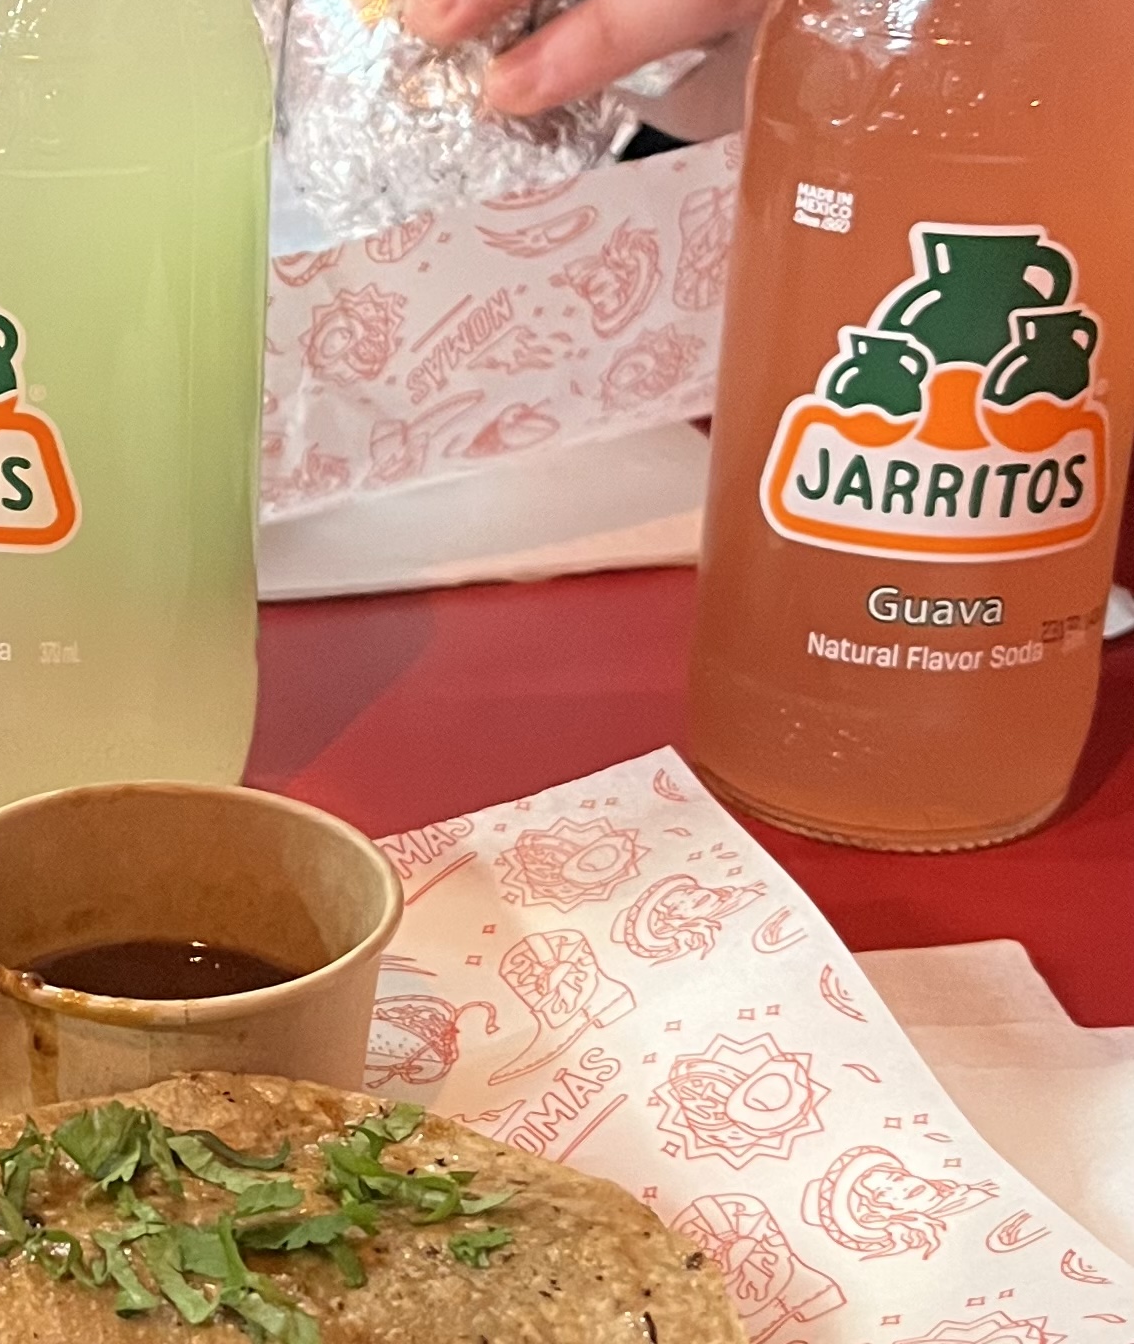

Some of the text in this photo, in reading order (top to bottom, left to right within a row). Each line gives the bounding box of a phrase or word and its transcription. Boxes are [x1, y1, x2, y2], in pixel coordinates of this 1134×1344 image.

[795, 195, 853, 219] MEXICO
[797, 181, 854, 206] MADE IN
[796, 448, 1087, 518] JARRITOS
[867, 586, 1005, 626] Guava
[807, 632, 899, 668] Natural
[907, 646, 984, 671] Flavor
[990, 640, 1043, 669] Soda
